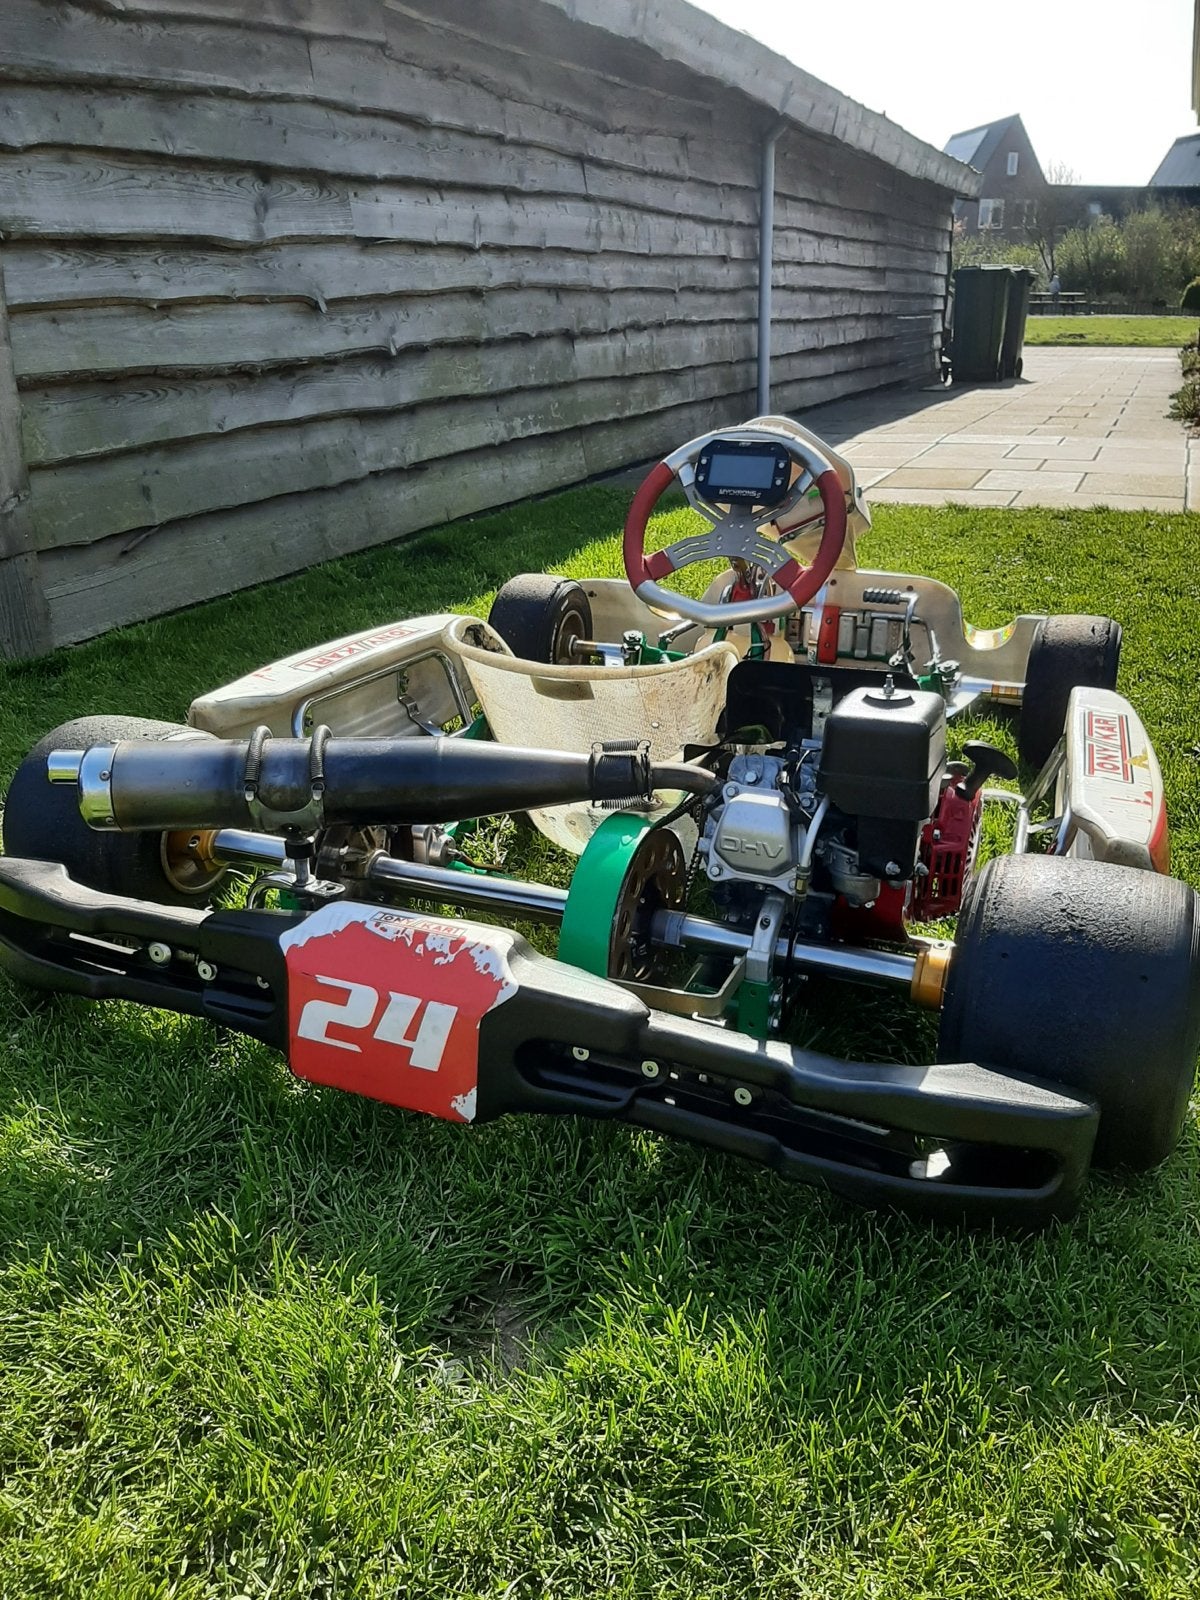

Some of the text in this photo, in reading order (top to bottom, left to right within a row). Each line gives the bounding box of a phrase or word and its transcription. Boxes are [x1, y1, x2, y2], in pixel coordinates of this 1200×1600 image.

[303, 642, 363, 671] KART
[1088, 711, 1122, 775] TONY KART
[720, 835, 784, 859] OHV
[379, 912, 463, 936] TONY KART
[297, 974, 459, 1073] 24
